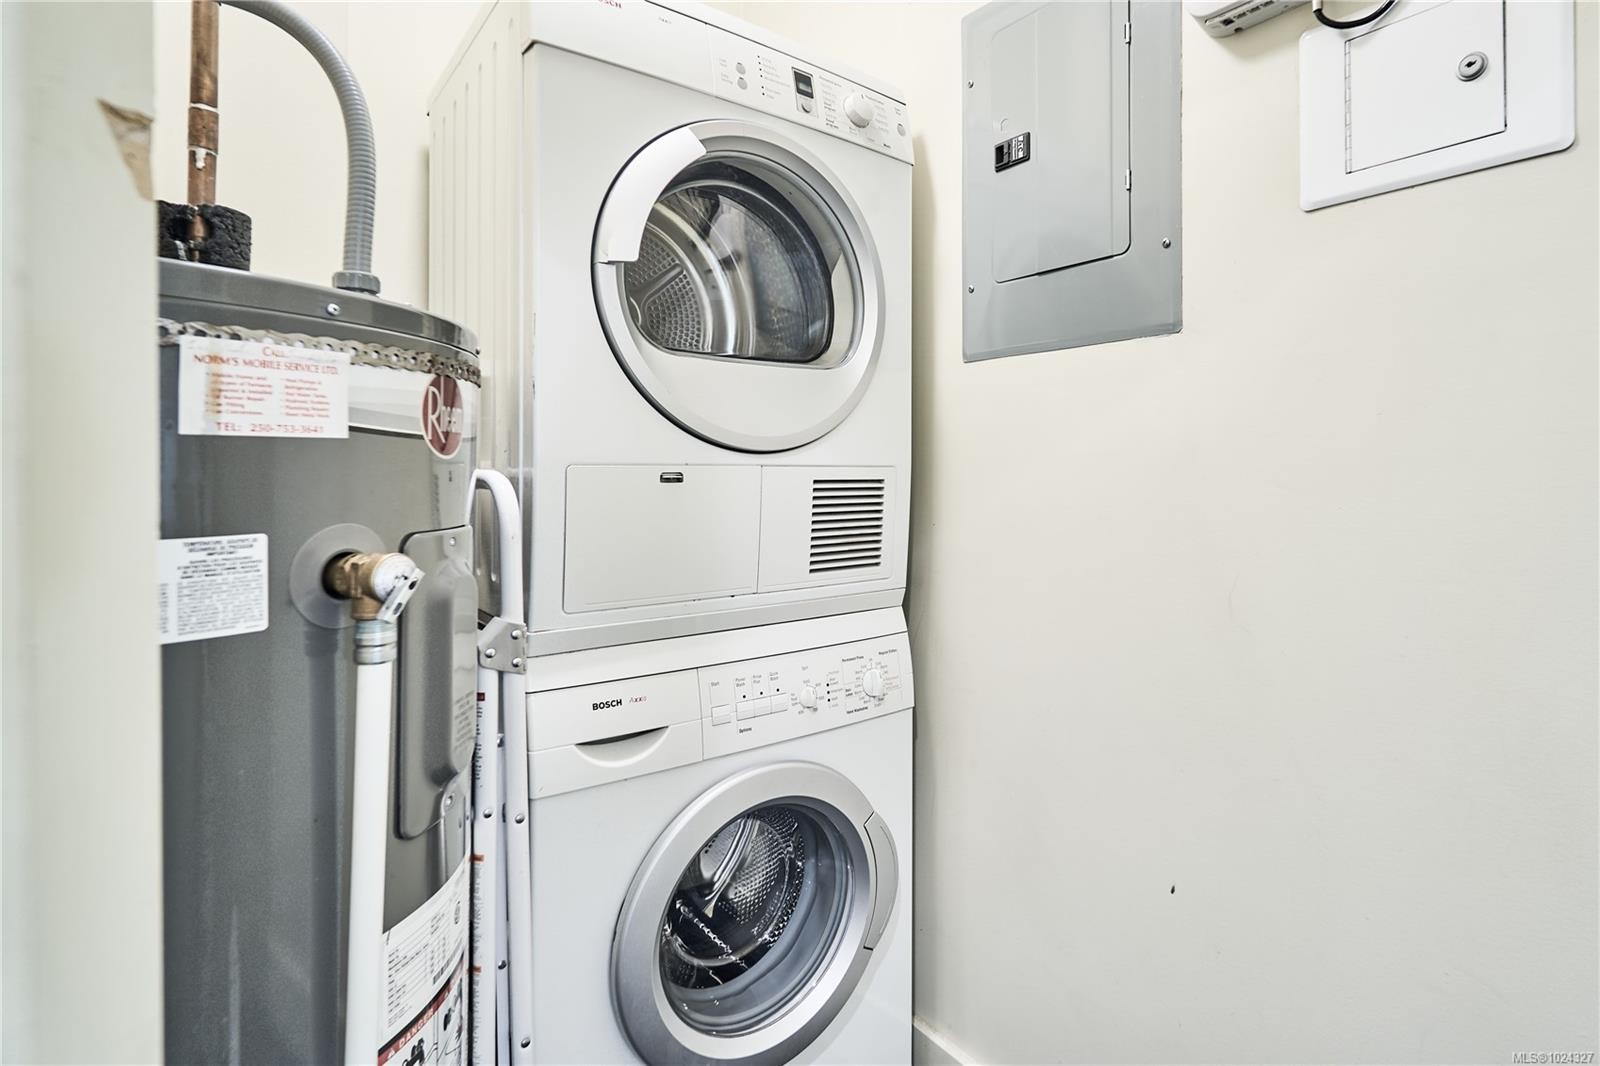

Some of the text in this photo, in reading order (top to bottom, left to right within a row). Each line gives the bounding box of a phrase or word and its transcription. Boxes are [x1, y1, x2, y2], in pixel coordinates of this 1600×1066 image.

[192, 354, 238, 366] NORM'S
[243, 358, 281, 370] MOBILE
[284, 362, 320, 373] SERVICE
[216, 421, 241, 432] TEL:
[592, 698, 623, 711] BOSCH
